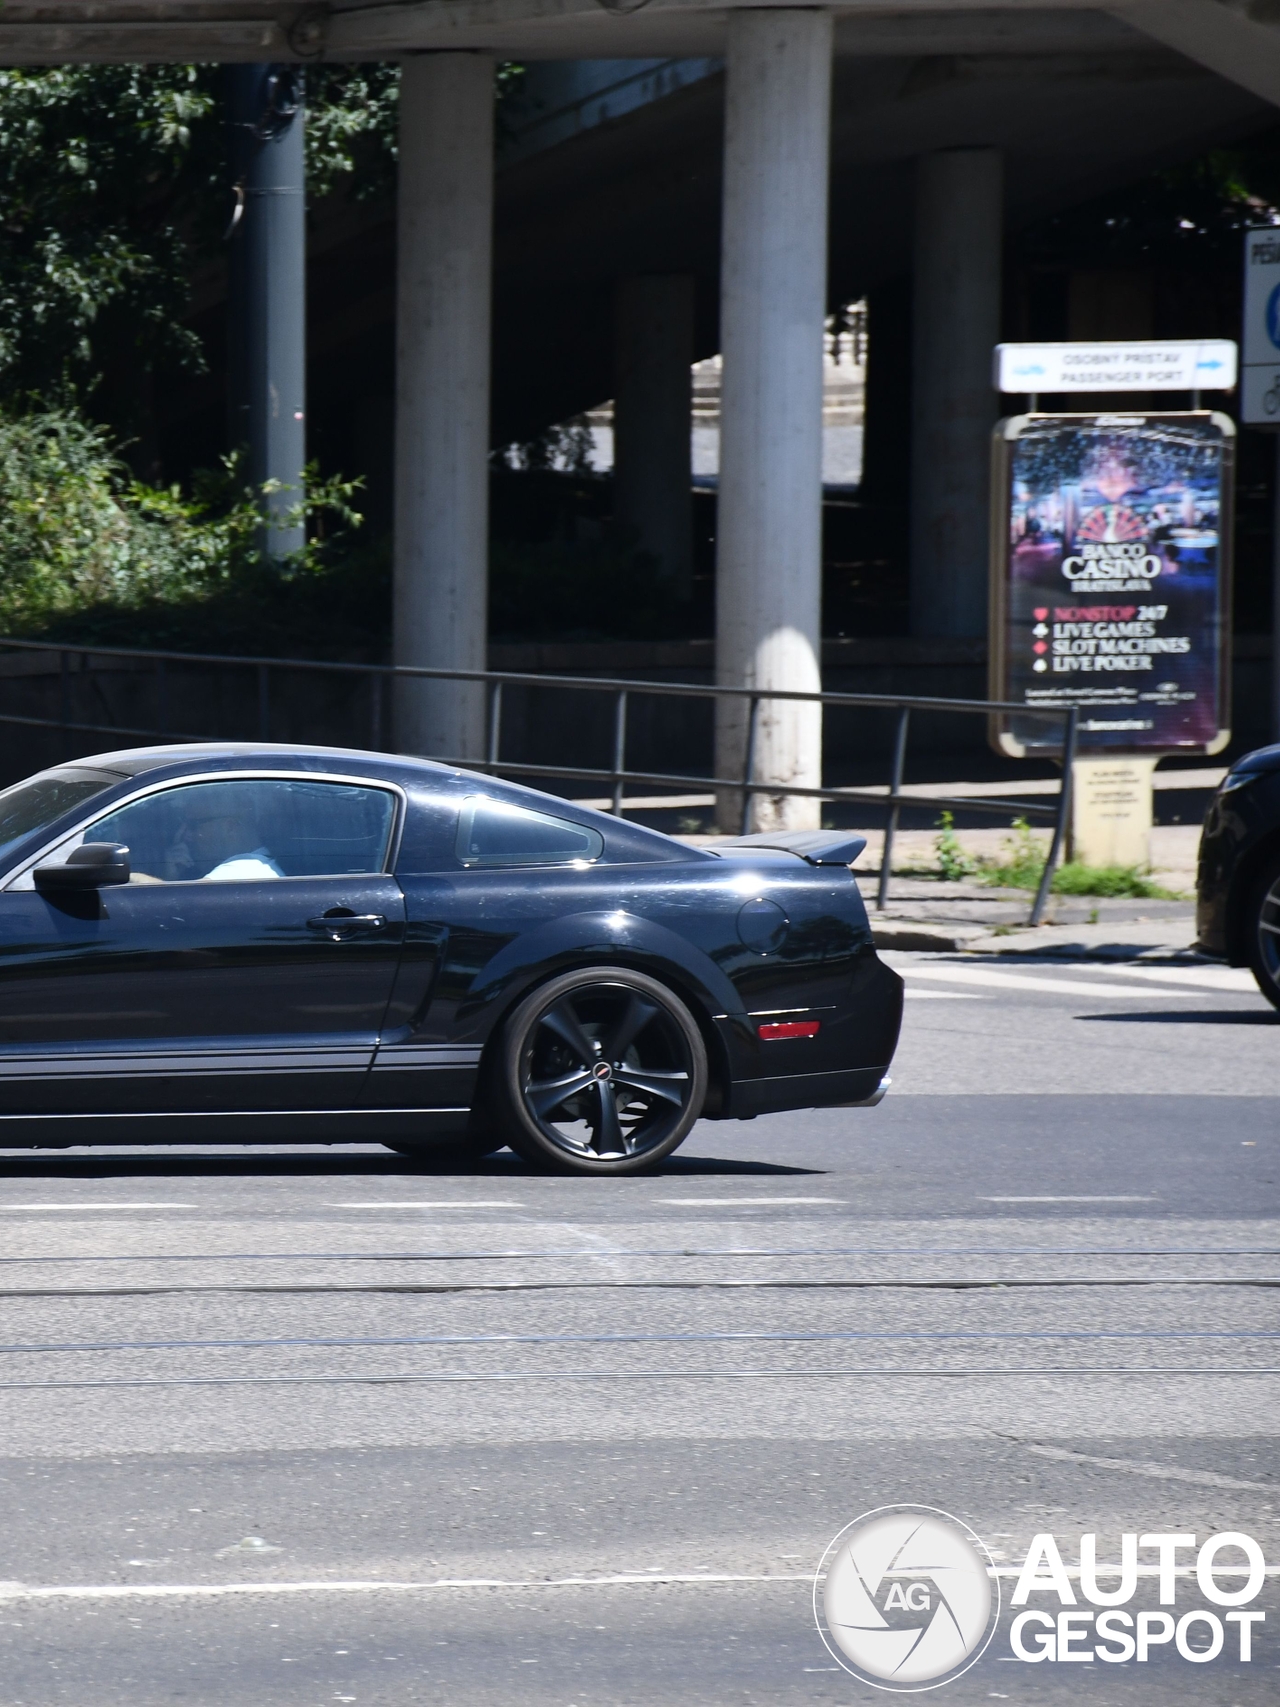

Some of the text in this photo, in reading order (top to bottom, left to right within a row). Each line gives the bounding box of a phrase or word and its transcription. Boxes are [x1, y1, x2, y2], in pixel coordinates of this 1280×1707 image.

[1061, 370, 1183, 384] PASSENGER PORT
[1082, 544, 1147, 560] BANCO
[1061, 555, 1162, 580] CASINO
[1053, 606, 1137, 622] NONSTOP
[1053, 622, 1156, 638] LIVE GAMES
[1052, 637, 1191, 655] SLOT MACHINES
[1053, 655, 1153, 672] LIVE POKER
